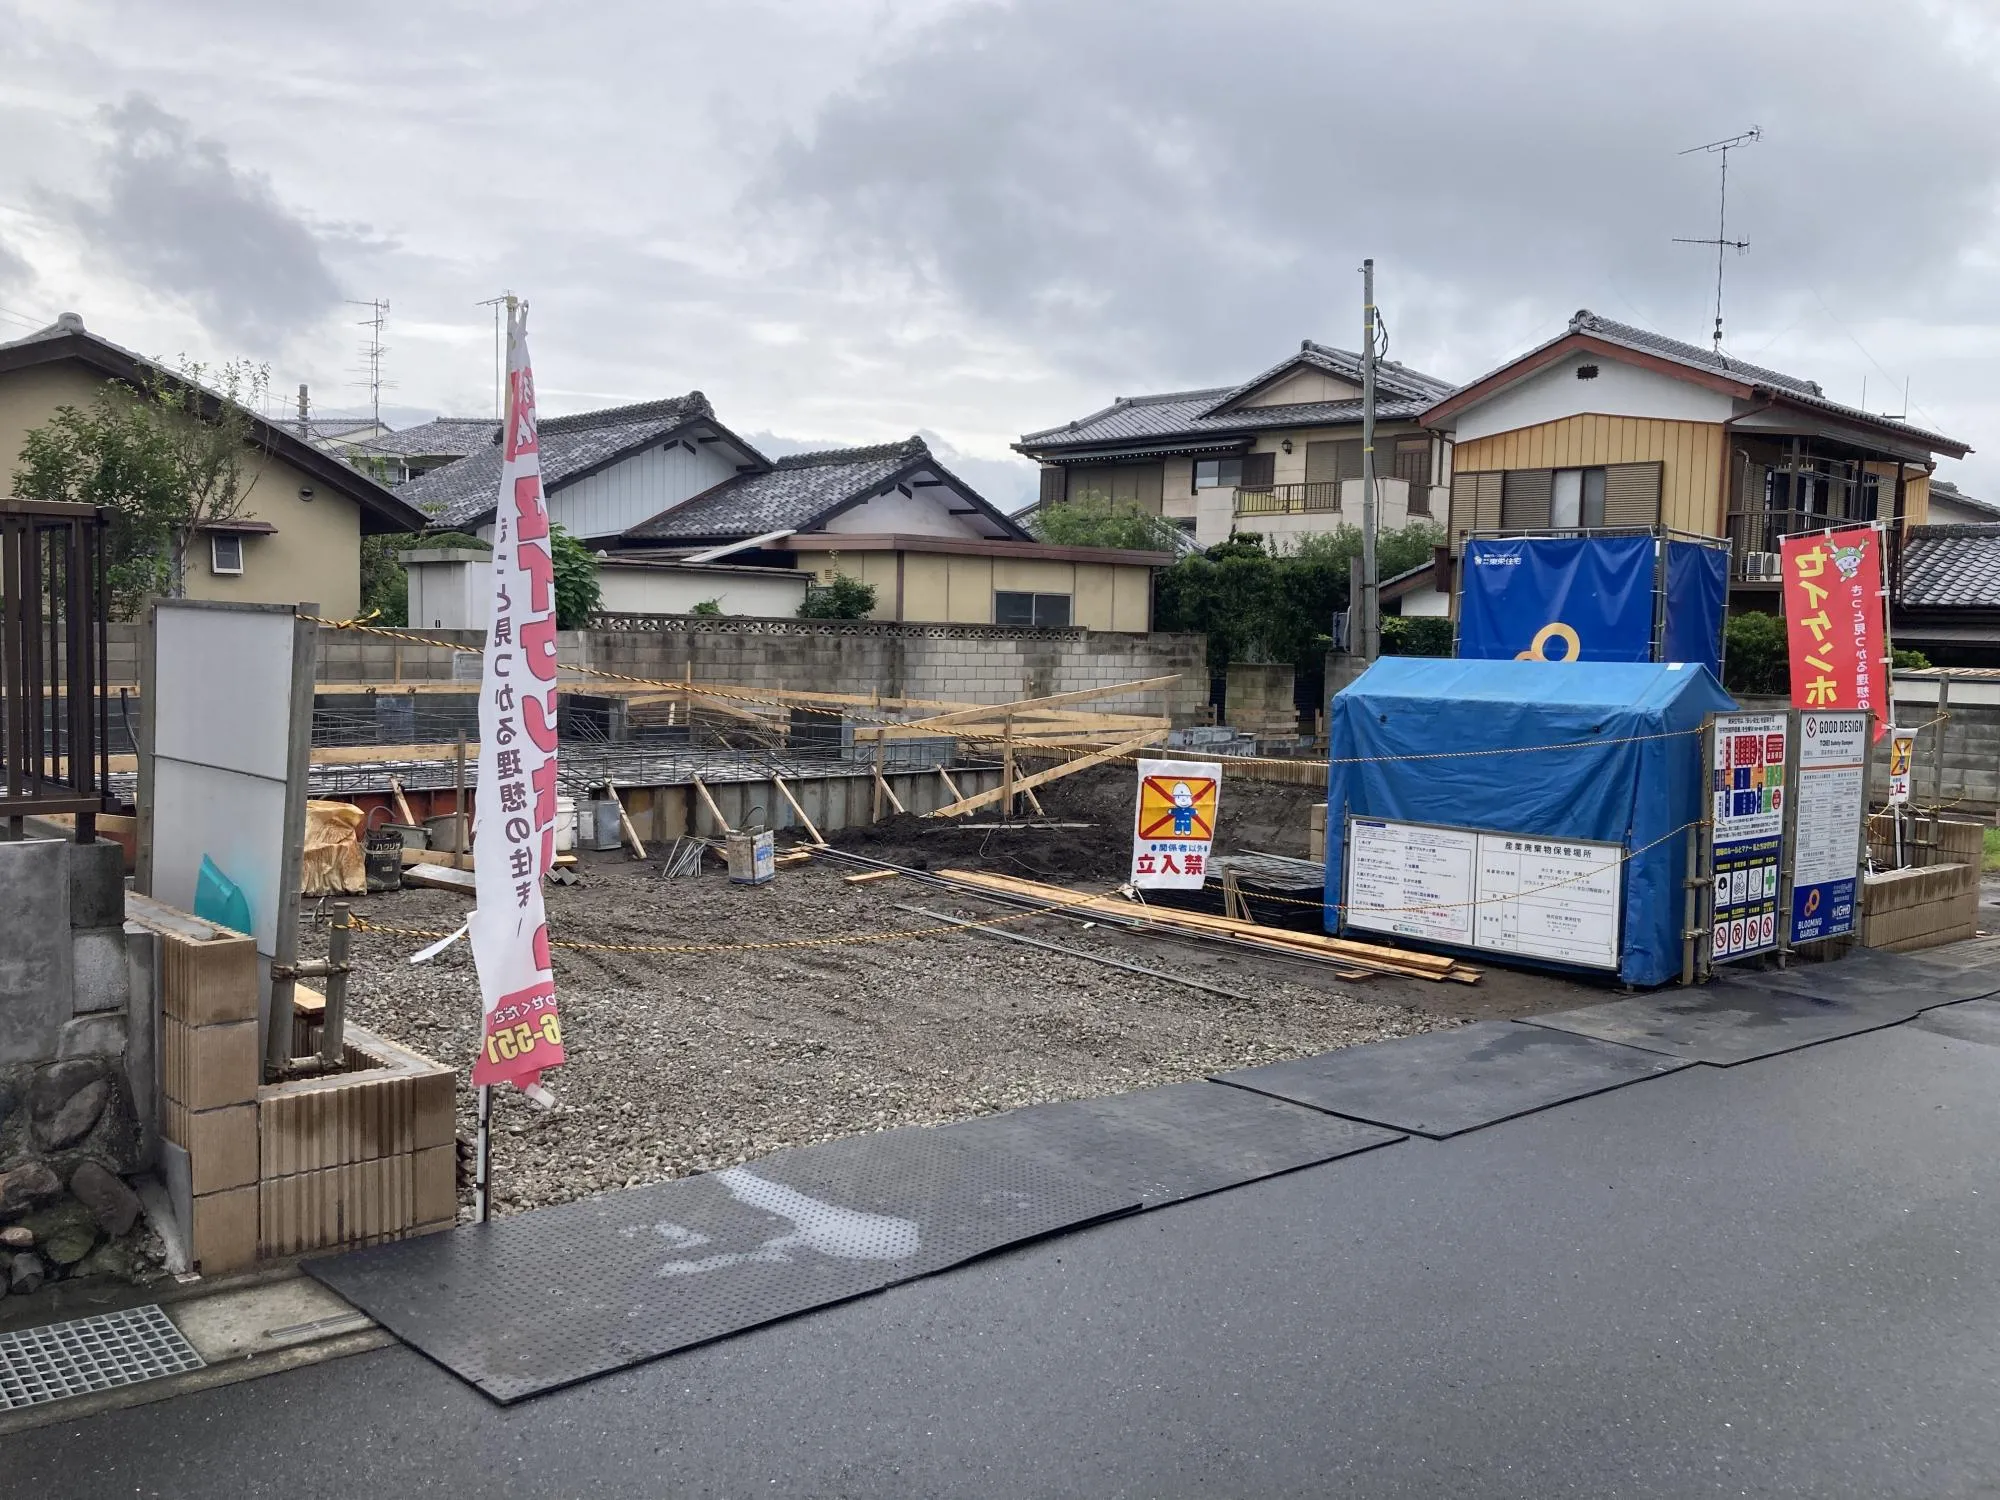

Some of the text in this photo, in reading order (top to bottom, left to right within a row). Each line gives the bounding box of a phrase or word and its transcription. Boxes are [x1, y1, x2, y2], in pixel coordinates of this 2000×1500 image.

[1819, 720, 1863, 733] GOOD DESIGN
[1505, 841, 1592, 859] 産業廃棄物保管場所
[1136, 854, 1206, 875] 立入禁
[1798, 917, 1823, 930] BLOOMING
[1799, 927, 1819, 939] GARDEN
